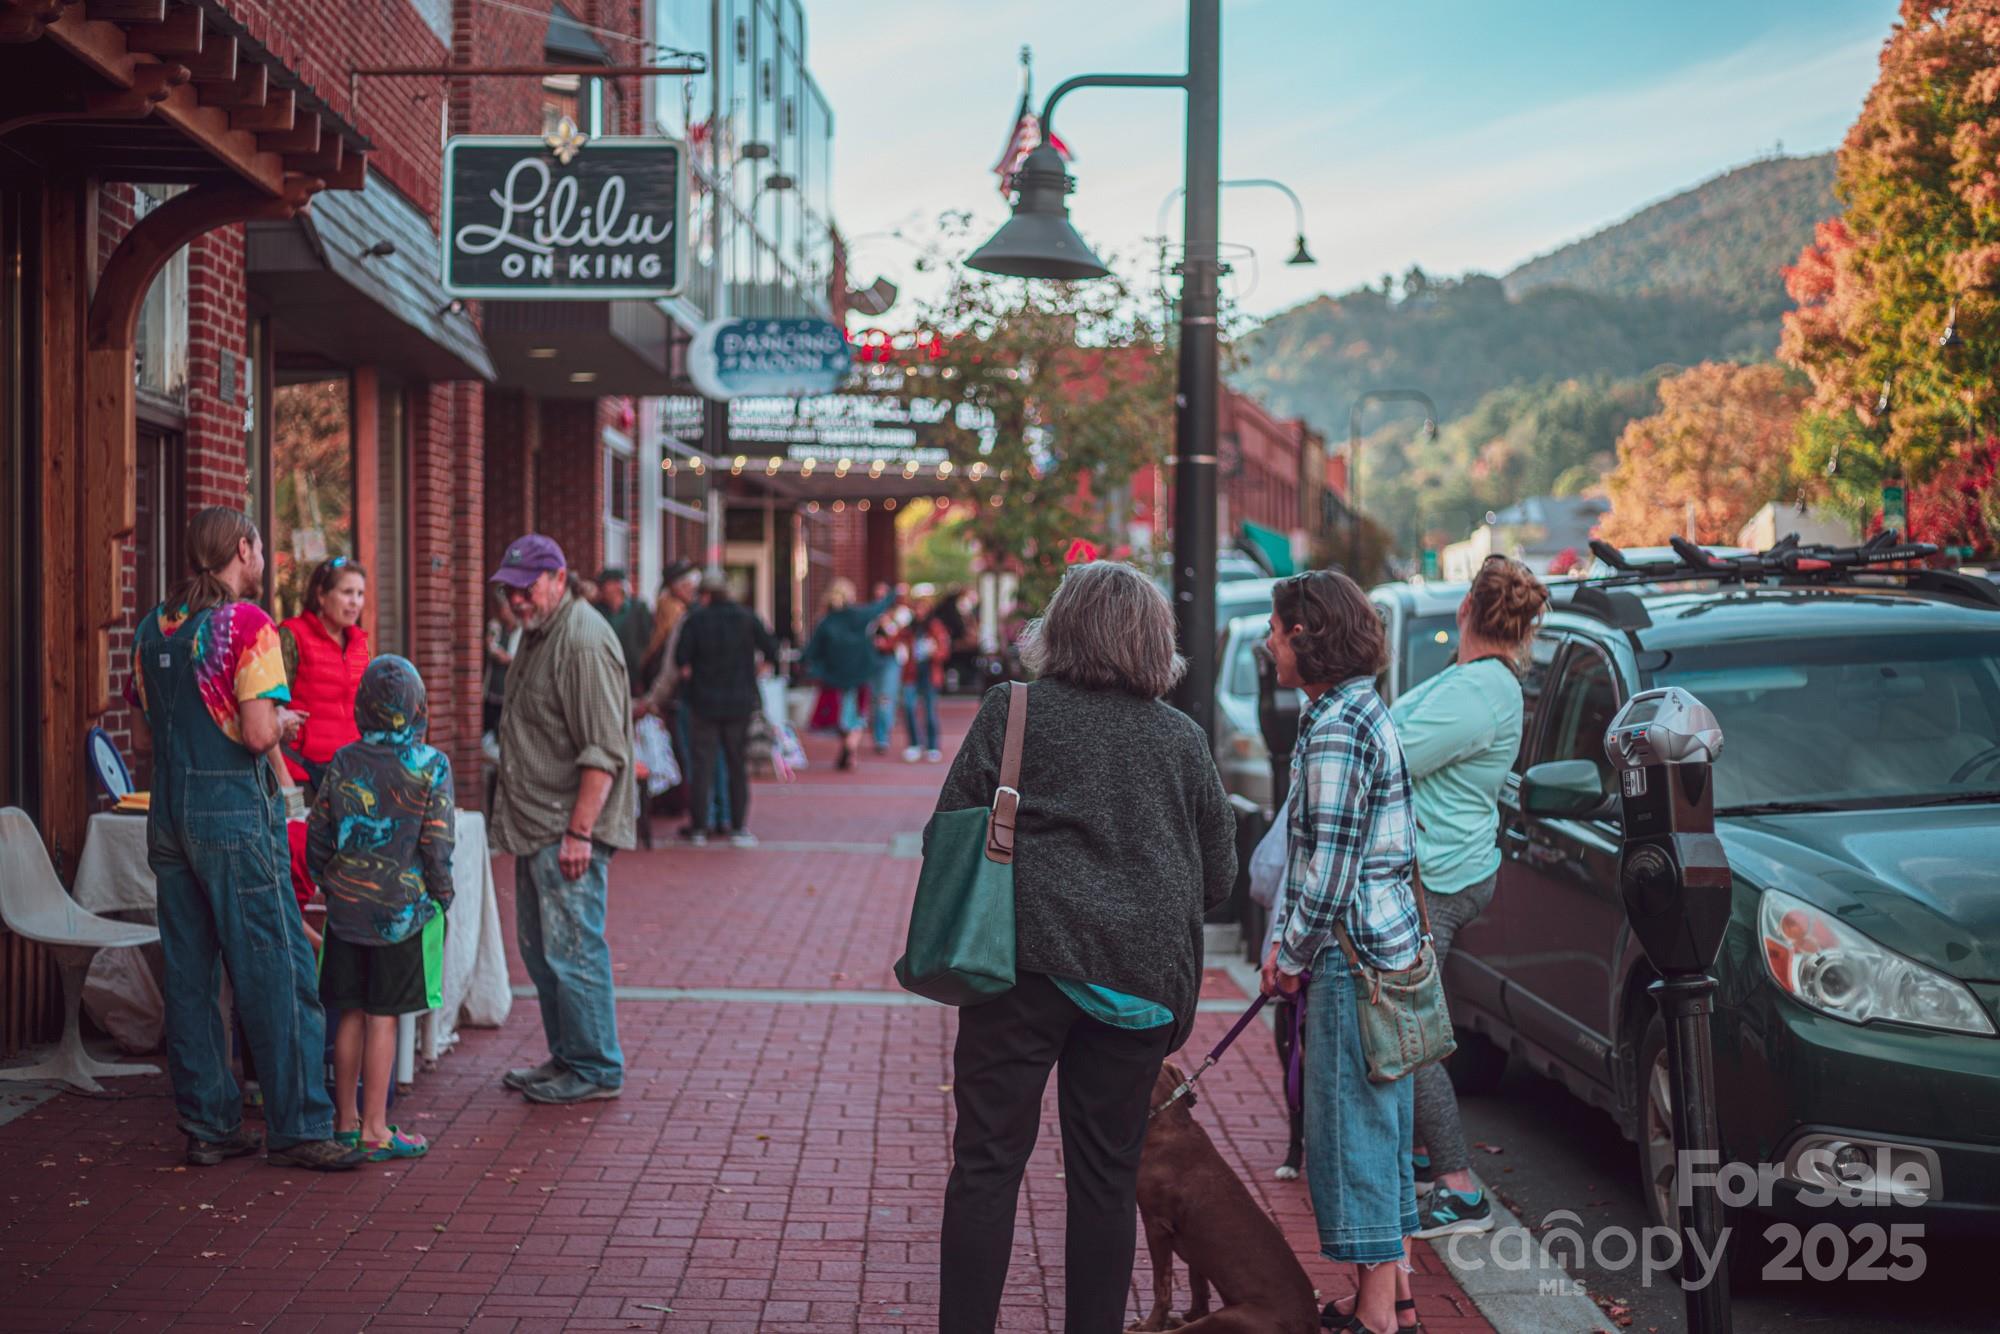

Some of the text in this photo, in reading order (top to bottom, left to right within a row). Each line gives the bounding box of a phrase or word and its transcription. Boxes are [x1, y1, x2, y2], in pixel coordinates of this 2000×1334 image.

[456, 157, 673, 254] Lililu
[502, 253, 662, 278] ON KING
[723, 333, 841, 354] DANCING
